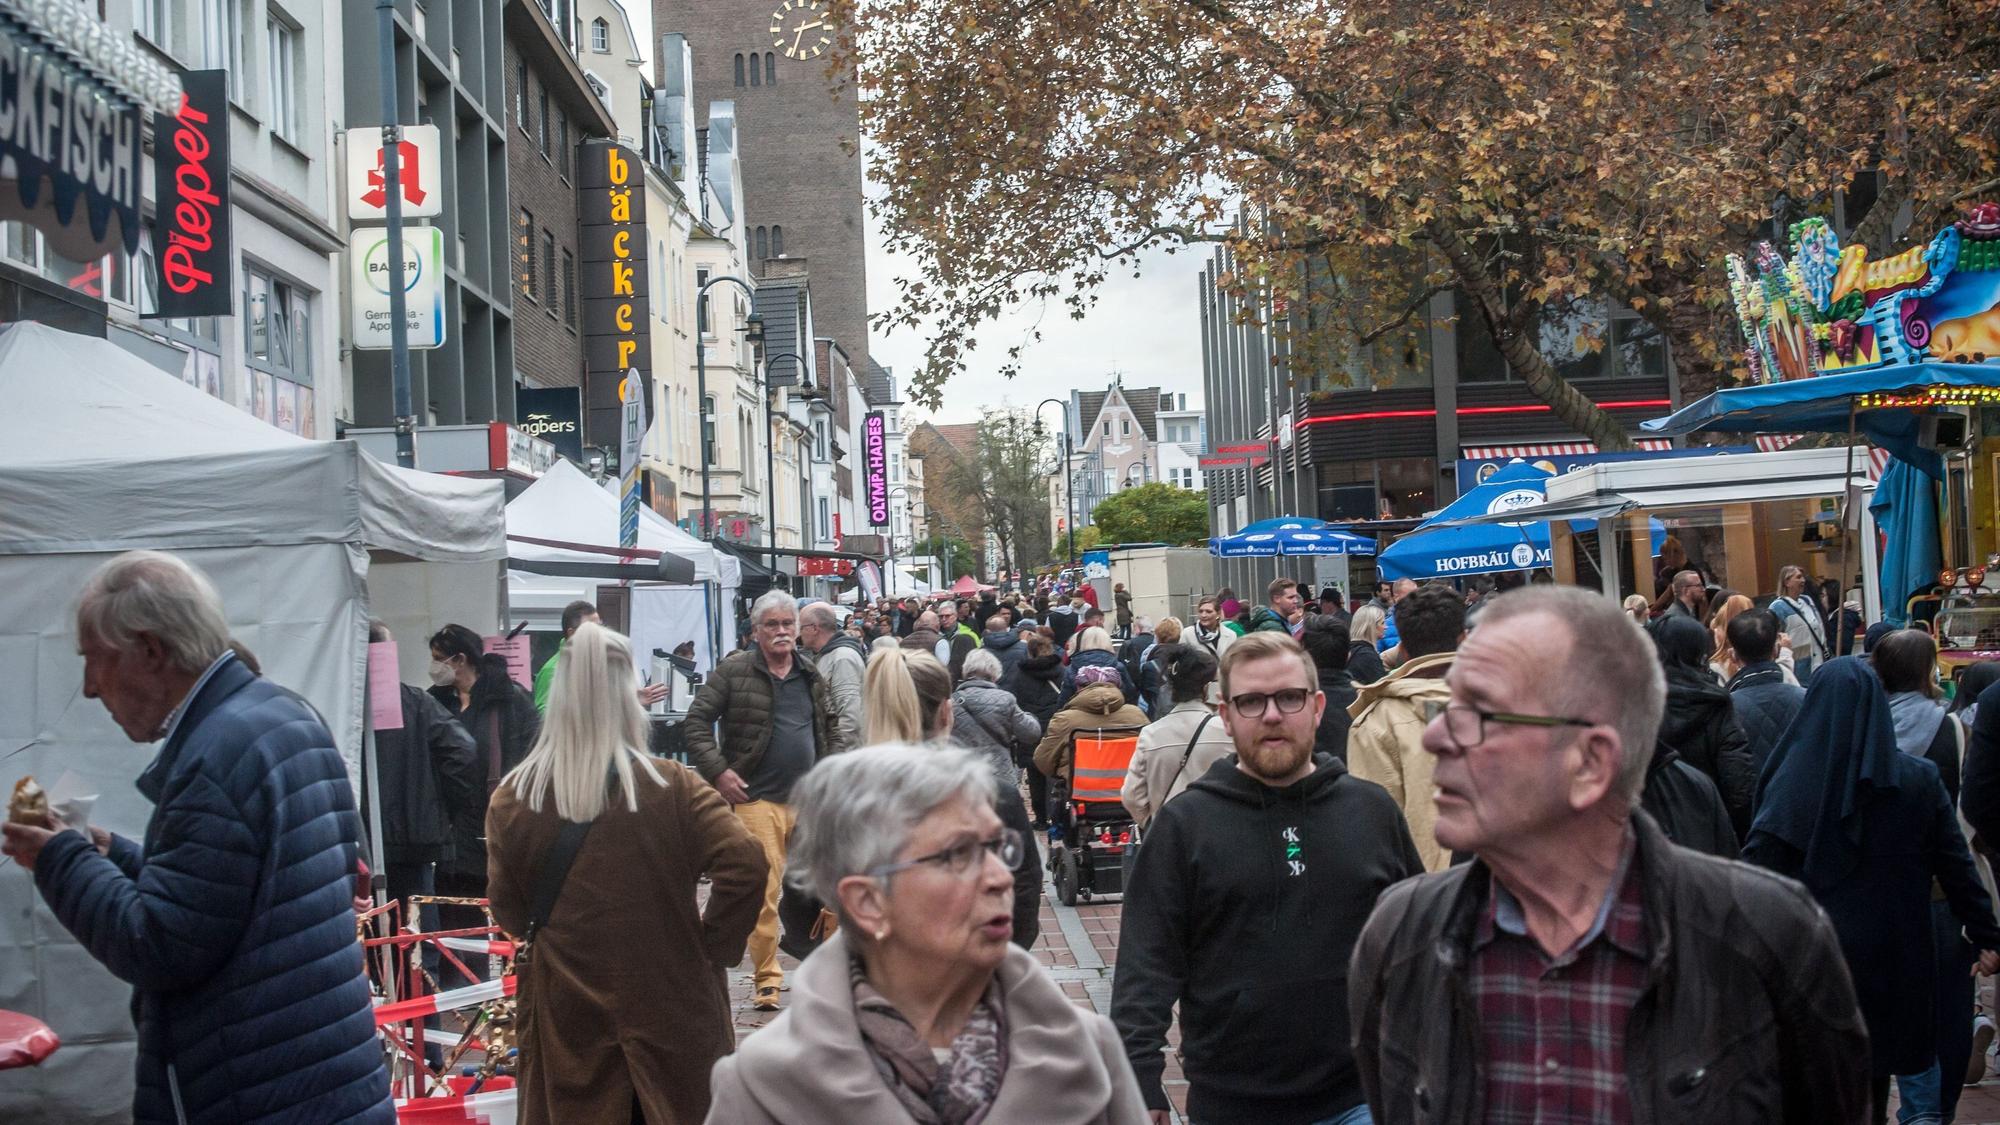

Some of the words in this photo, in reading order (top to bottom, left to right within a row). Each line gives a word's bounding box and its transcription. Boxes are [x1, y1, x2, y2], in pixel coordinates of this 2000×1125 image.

[163, 91, 220, 293] Pieper
[369, 262, 417, 272] BAER
[365, 310, 416, 320] Germia
[369, 321, 420, 333] Apoke
[517, 420, 575, 437] ngbers
[1435, 551, 1509, 571] HOFBRÄU
